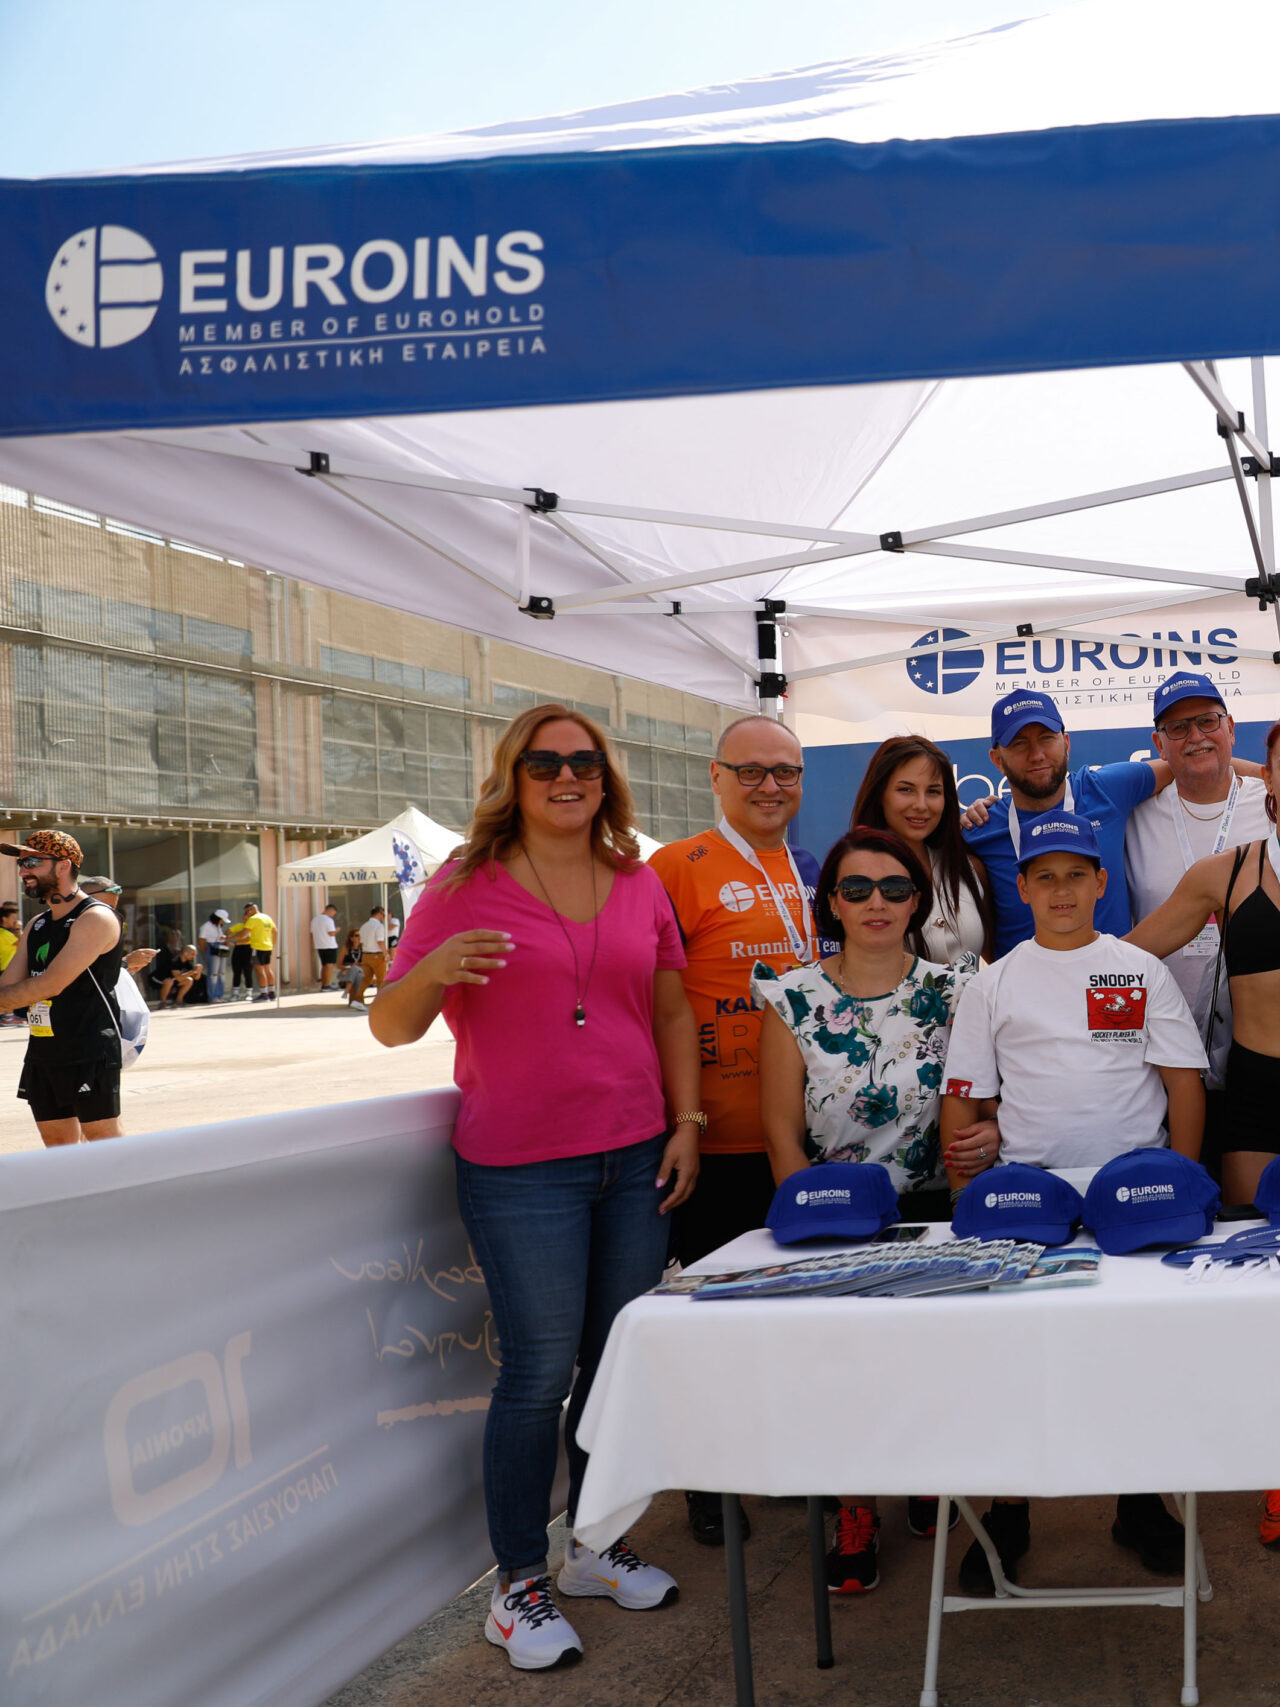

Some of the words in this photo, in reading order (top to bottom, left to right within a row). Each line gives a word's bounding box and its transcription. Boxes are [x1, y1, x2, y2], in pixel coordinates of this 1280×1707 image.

[179, 230, 545, 314] EUROINS
[179, 320, 305, 343] MEMBER
[323, 316, 360, 335] OF
[375, 304, 545, 332] EUROHOLD
[179, 347, 384, 376] ΑΣΦΑΛΙΣΤΙΚΗ
[403, 336, 546, 362] ΕΤΑΙΡΕΙΑ
[995, 627, 1240, 676] EUROINS
[995, 678, 1080, 691] MEMBER
[1092, 676, 1117, 687] OF
[1128, 670, 1242, 685] EUROLD
[1012, 700, 1043, 709] EUROINS
[1052, 692, 1133, 705] ΛΙΣΤΙΚΗ
[1042, 821, 1079, 833] EUROINS
[1089, 973, 1145, 987] SNOOPY
[809, 1189, 851, 1200] EUROINS
[1130, 1184, 1174, 1197] EUROINS
[998, 1192, 1041, 1203] EUROINS
